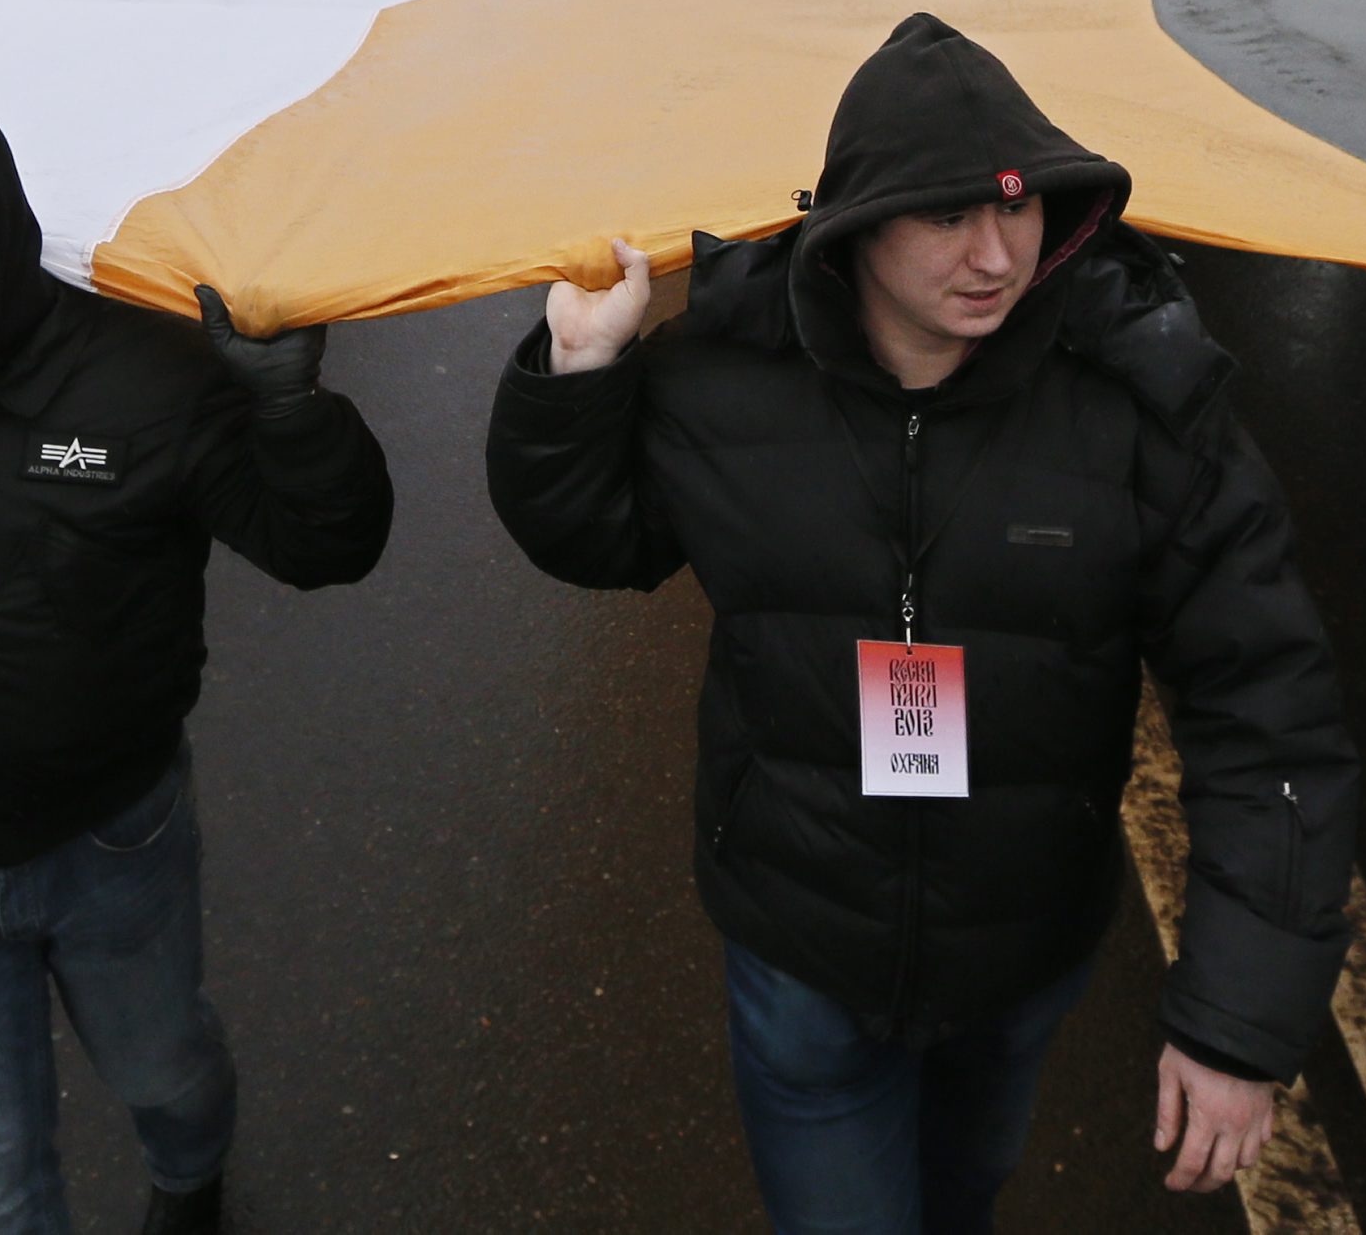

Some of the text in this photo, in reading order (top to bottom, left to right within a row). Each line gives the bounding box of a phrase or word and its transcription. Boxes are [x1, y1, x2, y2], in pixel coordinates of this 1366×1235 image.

[27, 465, 116, 481] ALPHA INDUSTRIES
[894, 708, 934, 737] 2013
[890, 752, 939, 775] ОХРАНА
